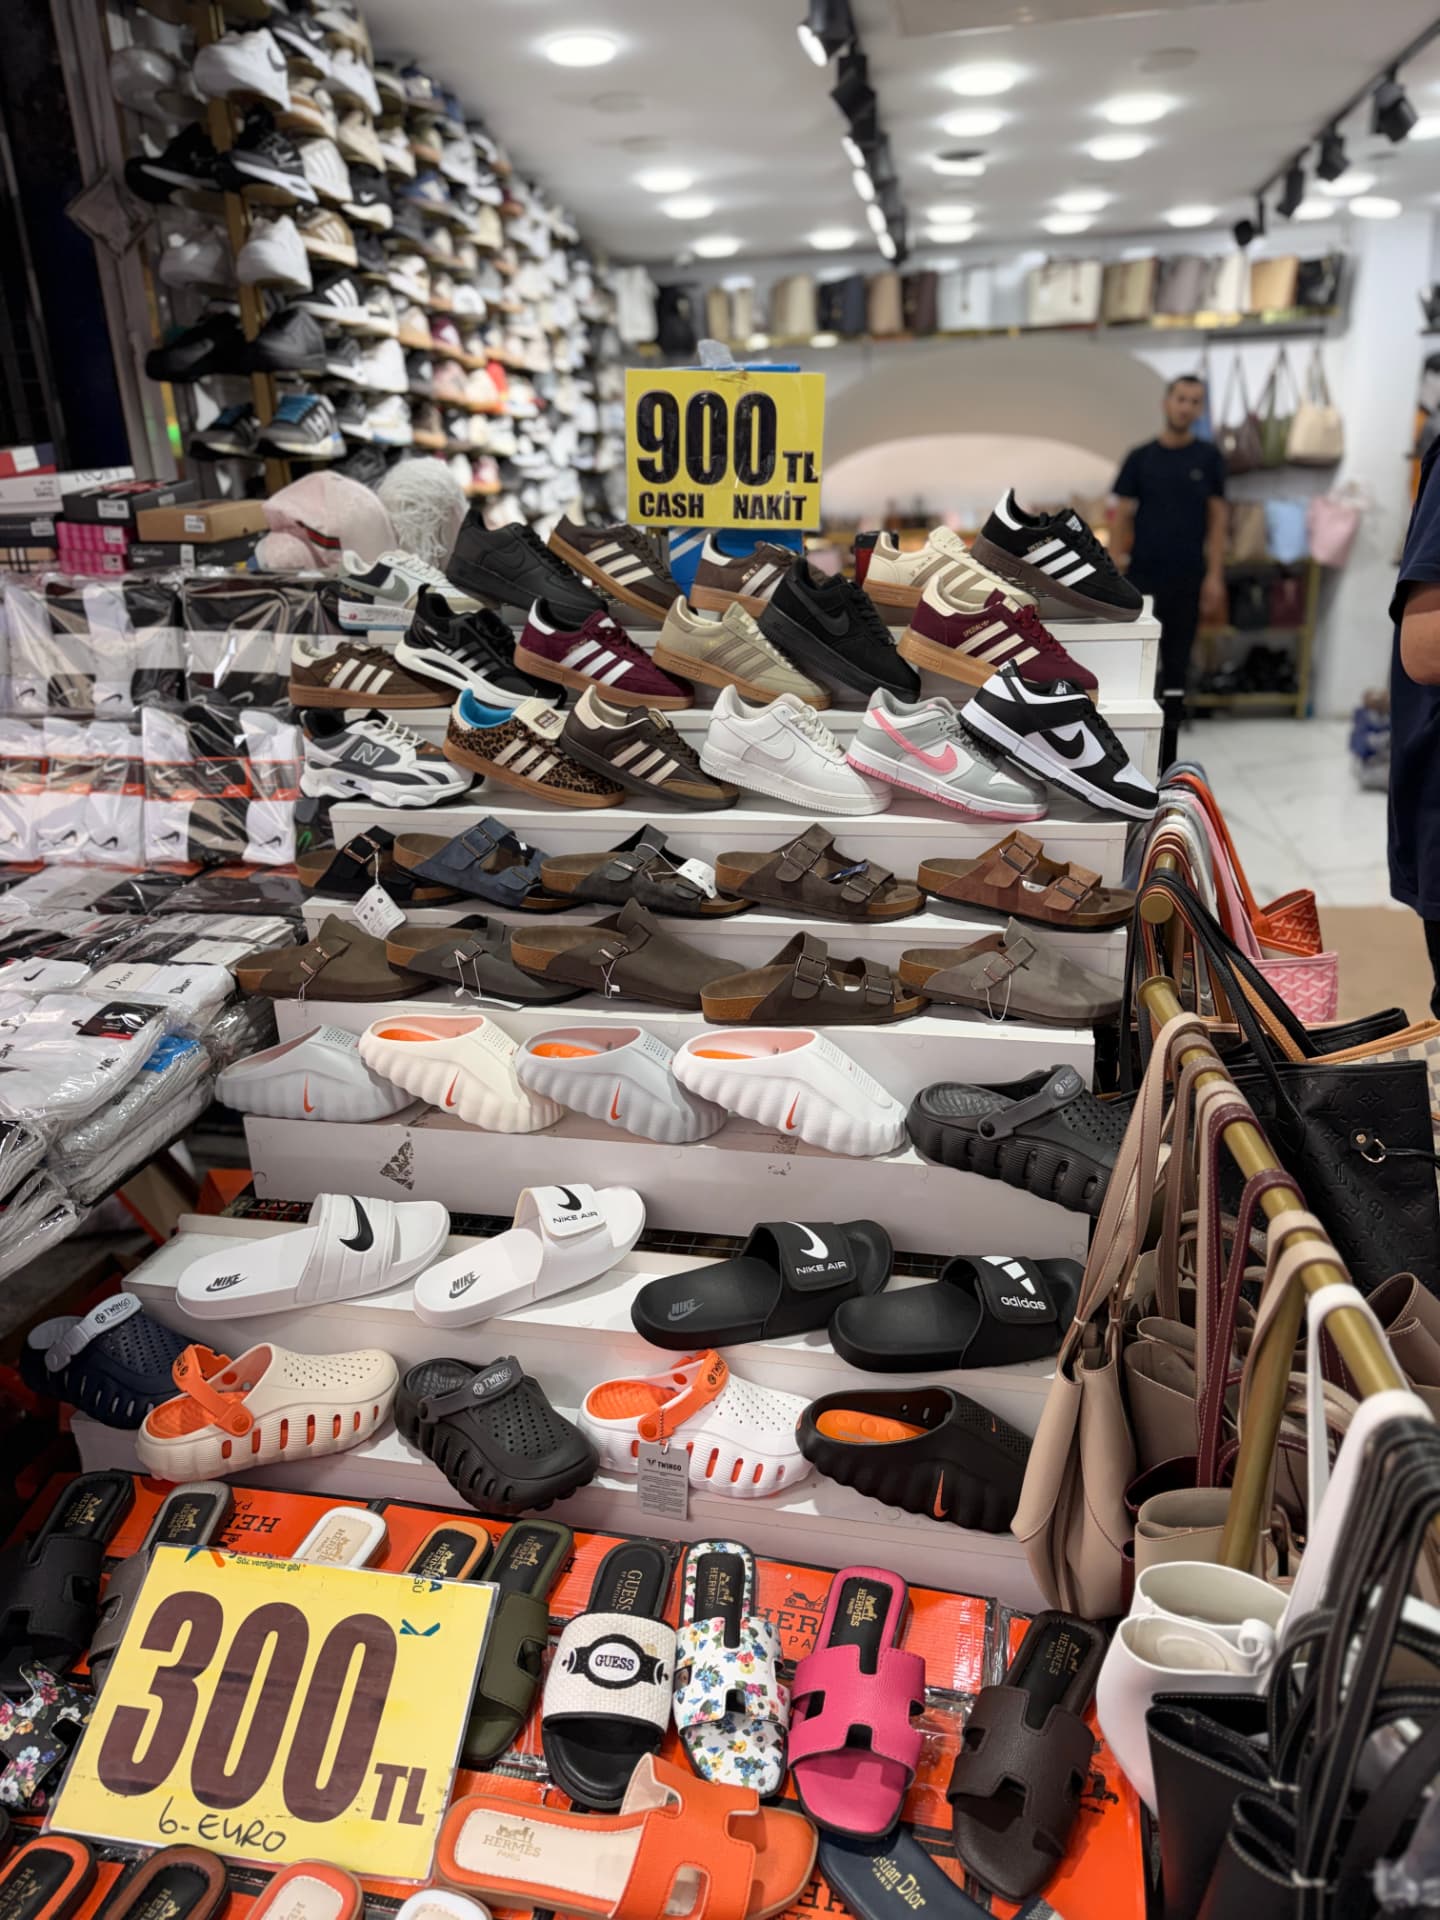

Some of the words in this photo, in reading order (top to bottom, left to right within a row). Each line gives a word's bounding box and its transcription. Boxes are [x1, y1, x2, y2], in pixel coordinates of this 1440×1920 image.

[636, 389, 778, 487] 900
[782, 450, 819, 484] TL
[638, 492, 705, 519] CASH
[733, 491, 807, 521] NAKİT
[553, 1213, 578, 1224] NIKE
[581, 1210, 599, 1220] AIR
[796, 1264, 825, 1276] NIKE
[827, 1261, 848, 1272] AIR
[212, 1272, 241, 1288] NIKE
[452, 1270, 476, 1292] NIKE
[671, 1298, 696, 1316] NIKE
[1000, 1295, 1047, 1311] adidas
[483, 1367, 512, 1389] TWINGO
[658, 1460, 682, 1472] TWINGO
[617, 1569, 643, 1612] GUESS
[595, 1654, 635, 1672] GUESS
[97, 1590, 398, 1823] 300
[370, 1762, 428, 1827] TL
[871, 1866, 894, 1892] PARIS
[896, 1874, 926, 1910] Dior
